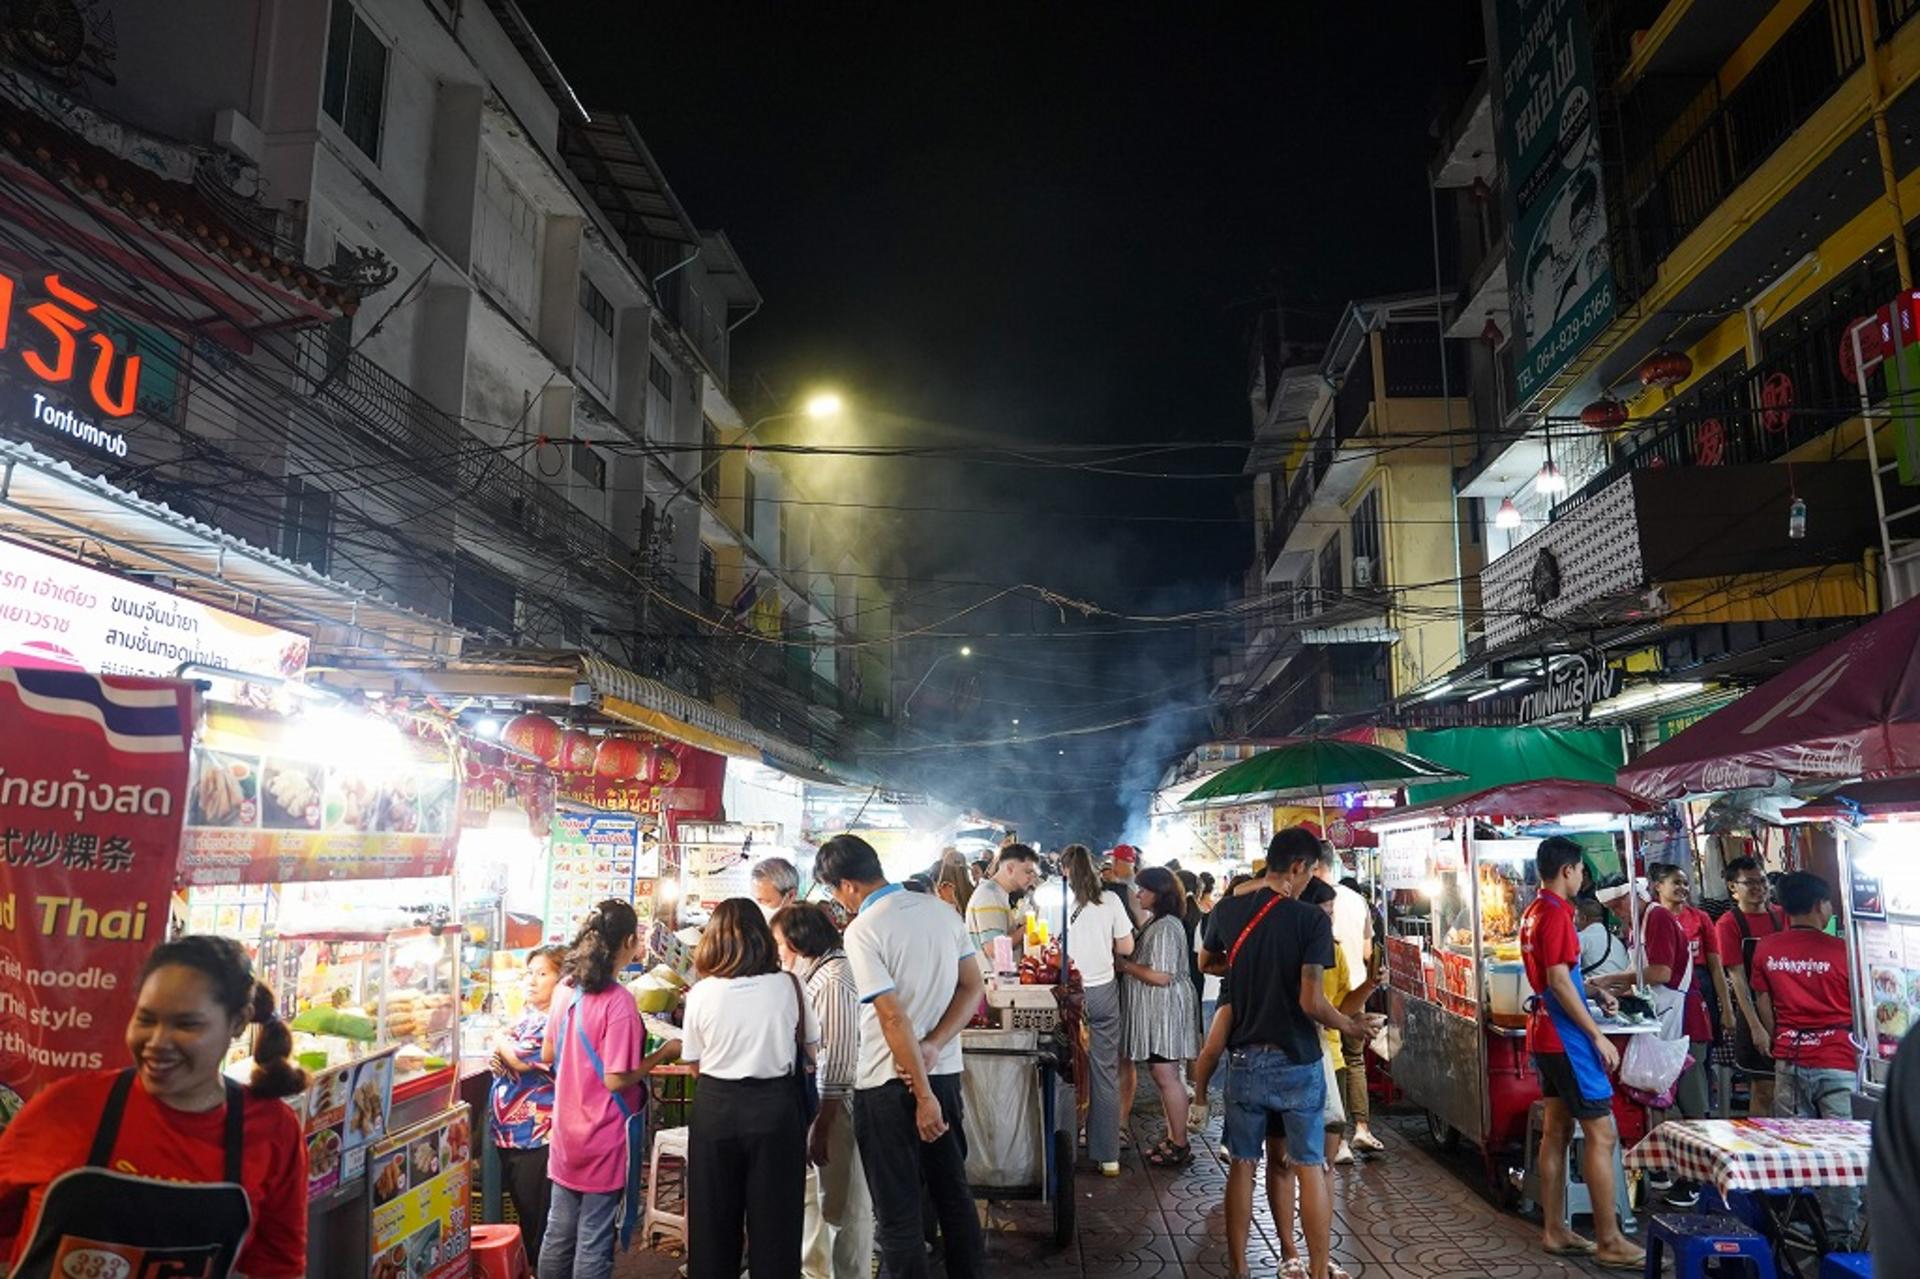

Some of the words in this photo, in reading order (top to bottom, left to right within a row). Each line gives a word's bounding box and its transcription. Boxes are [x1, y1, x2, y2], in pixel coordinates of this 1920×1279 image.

[32, 393, 127, 458] Tontumrub
[0, 767, 171, 822] ทยกุ้งสด
[36, 895, 148, 941] Thai
[26, 967, 118, 990] noodle
[30, 1006, 93, 1031] style
